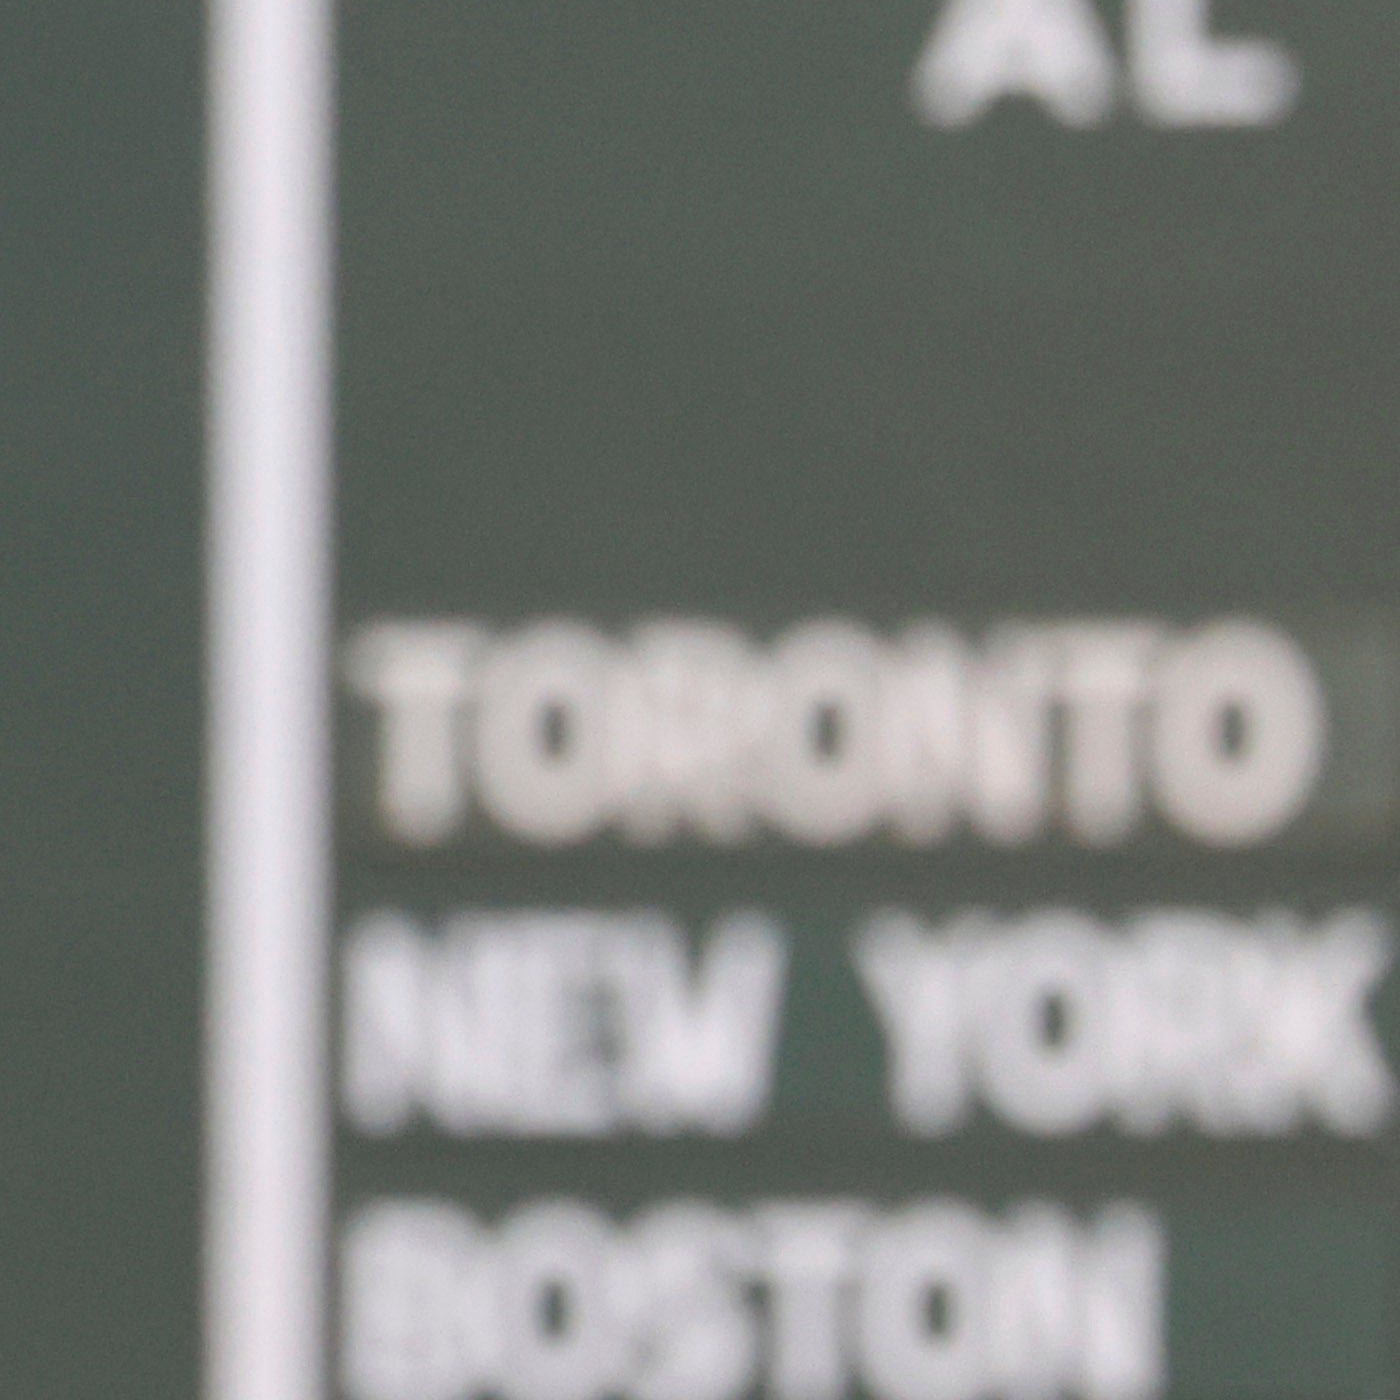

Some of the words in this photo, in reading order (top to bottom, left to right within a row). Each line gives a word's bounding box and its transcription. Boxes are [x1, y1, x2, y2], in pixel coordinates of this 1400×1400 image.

[347, 617, 1324, 845] TORONTO
[344, 910, 787, 1136] NEW
[854, 908, 1394, 1135] YORK
[343, 1199, 1166, 1400] BOSTON
